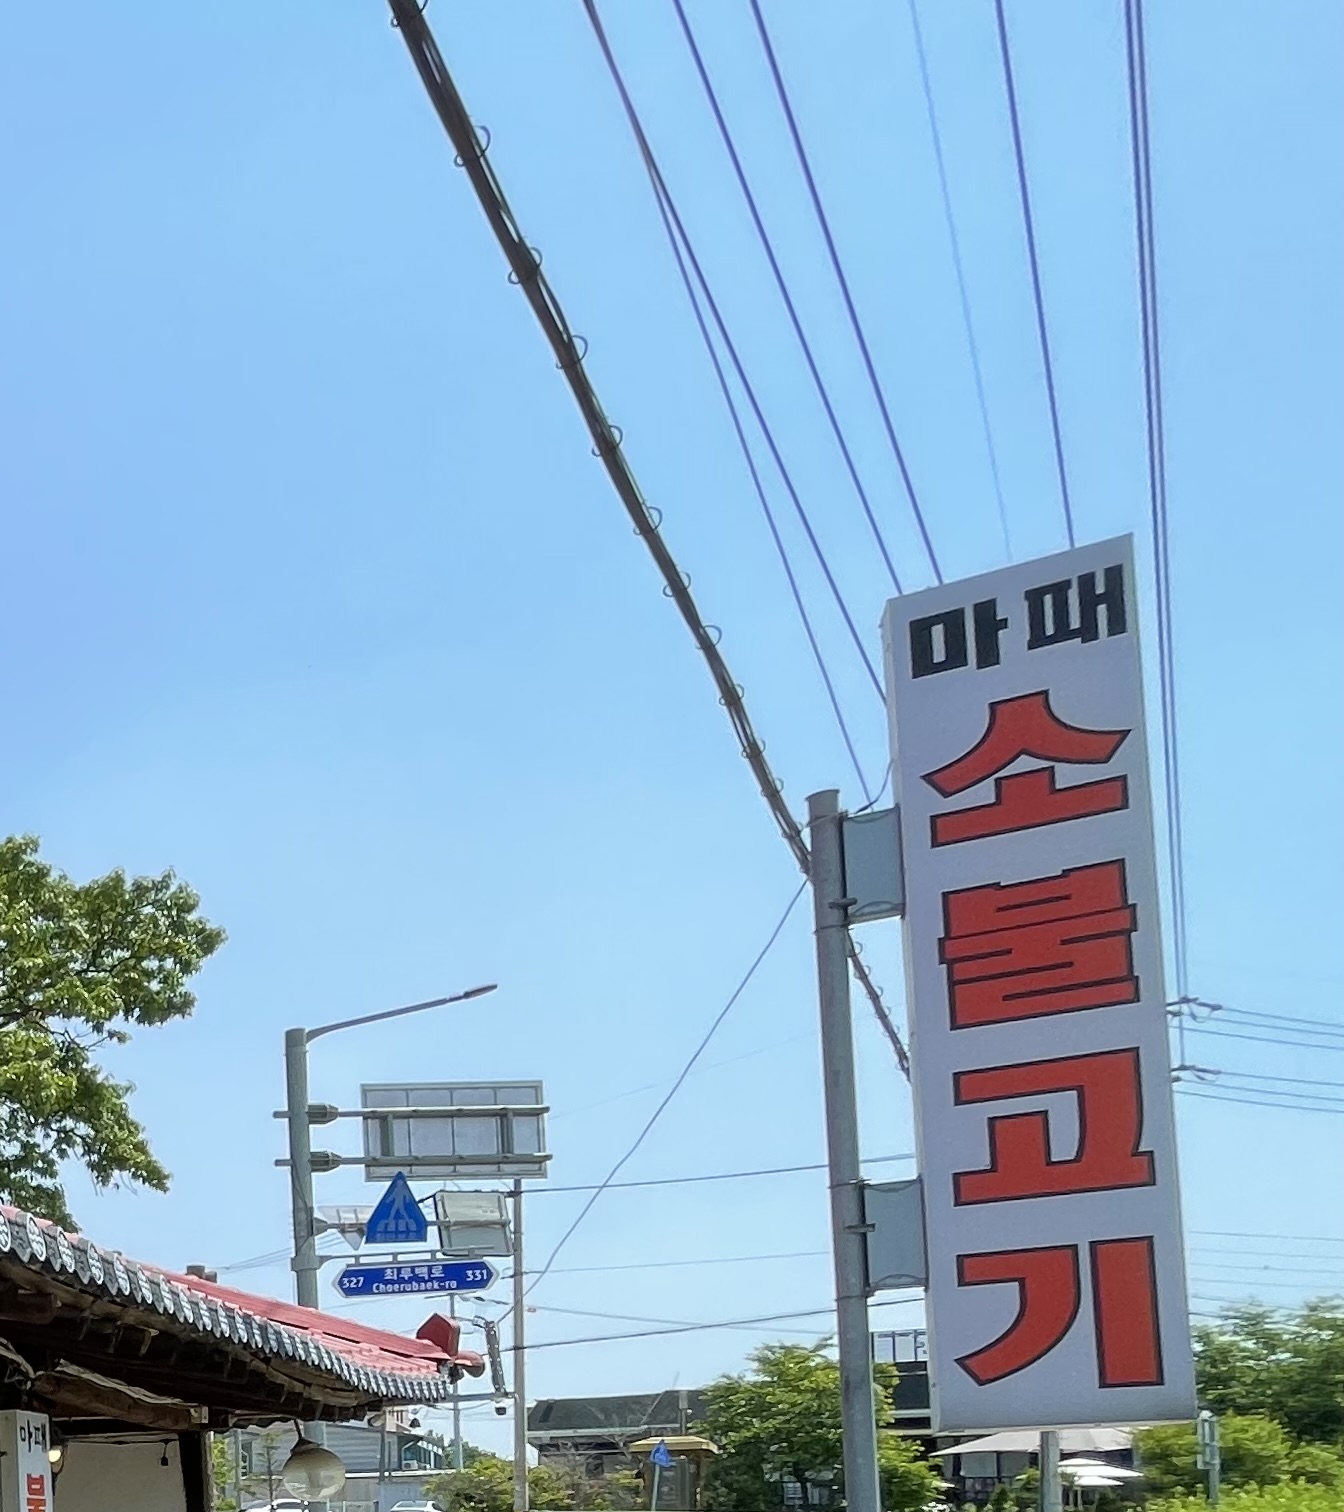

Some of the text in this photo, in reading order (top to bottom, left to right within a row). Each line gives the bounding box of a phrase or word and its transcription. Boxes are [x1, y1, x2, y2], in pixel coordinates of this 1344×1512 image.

[909, 564, 1128, 679] 마패
[921, 689, 1165, 1391] 소불고기
[384, 1265, 445, 1281] 최루백로
[465, 1269, 488, 1281] 331
[342, 1276, 364, 1289] 327
[372, 1279, 457, 1294] Choerubaek-ro
